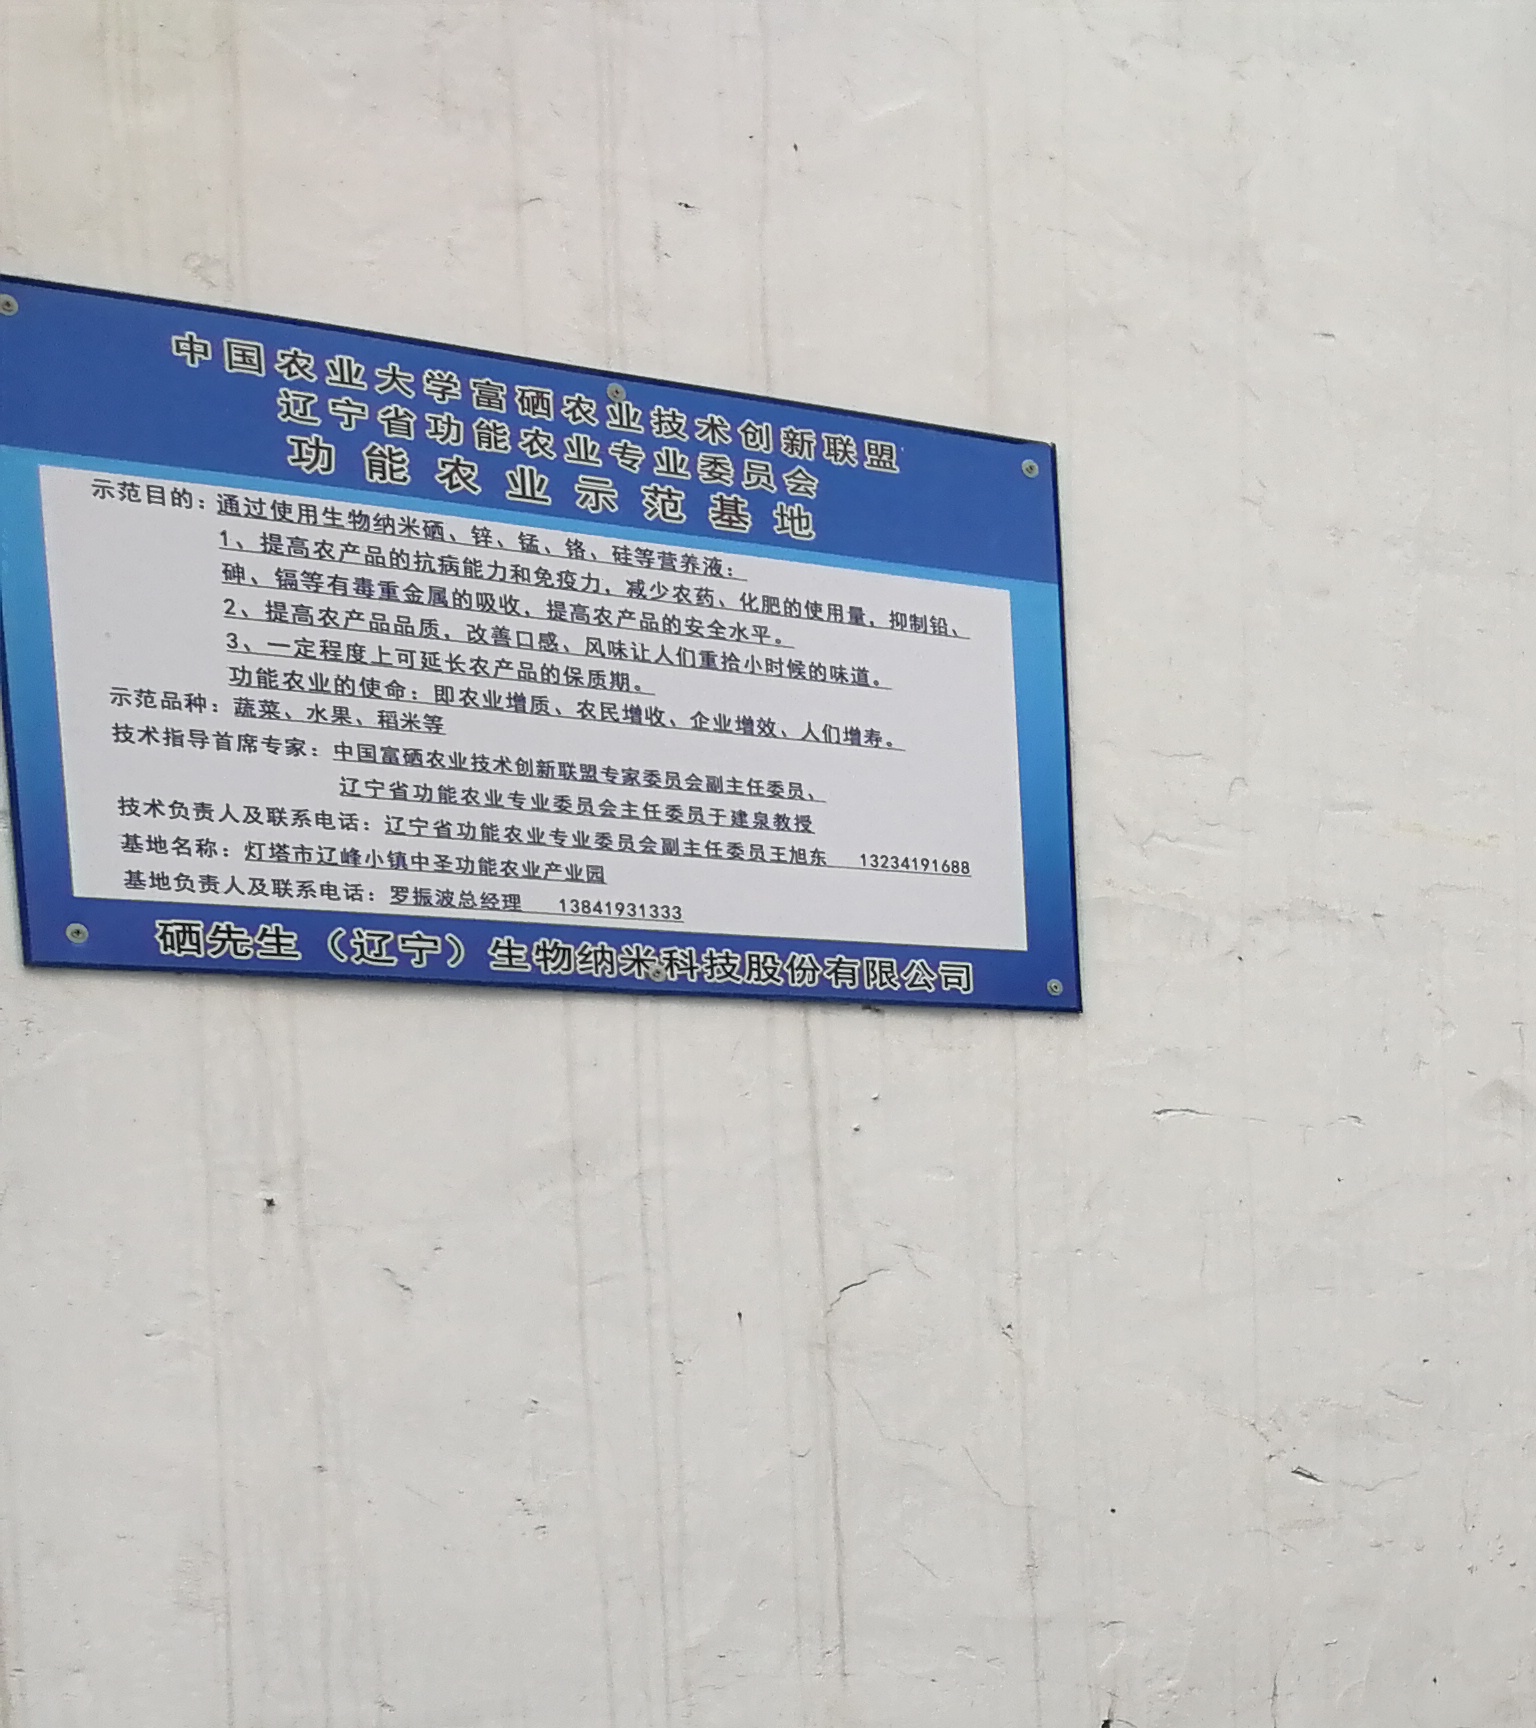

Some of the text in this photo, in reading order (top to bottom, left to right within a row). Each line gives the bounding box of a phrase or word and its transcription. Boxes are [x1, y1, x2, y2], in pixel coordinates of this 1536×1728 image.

[171, 332, 899, 473] 中国农业大学富硒农业技术创新联盟
[277, 389, 819, 499] 辽宁省功能农业专业委员会
[288, 435, 815, 540] 功能农业示范基地
[339, 776, 814, 833] 辽宁省功能农业专业委员会主任委员于建泉教授
[860, 853, 971, 876] 13234191688
[559, 898, 683, 920] 13841931333
